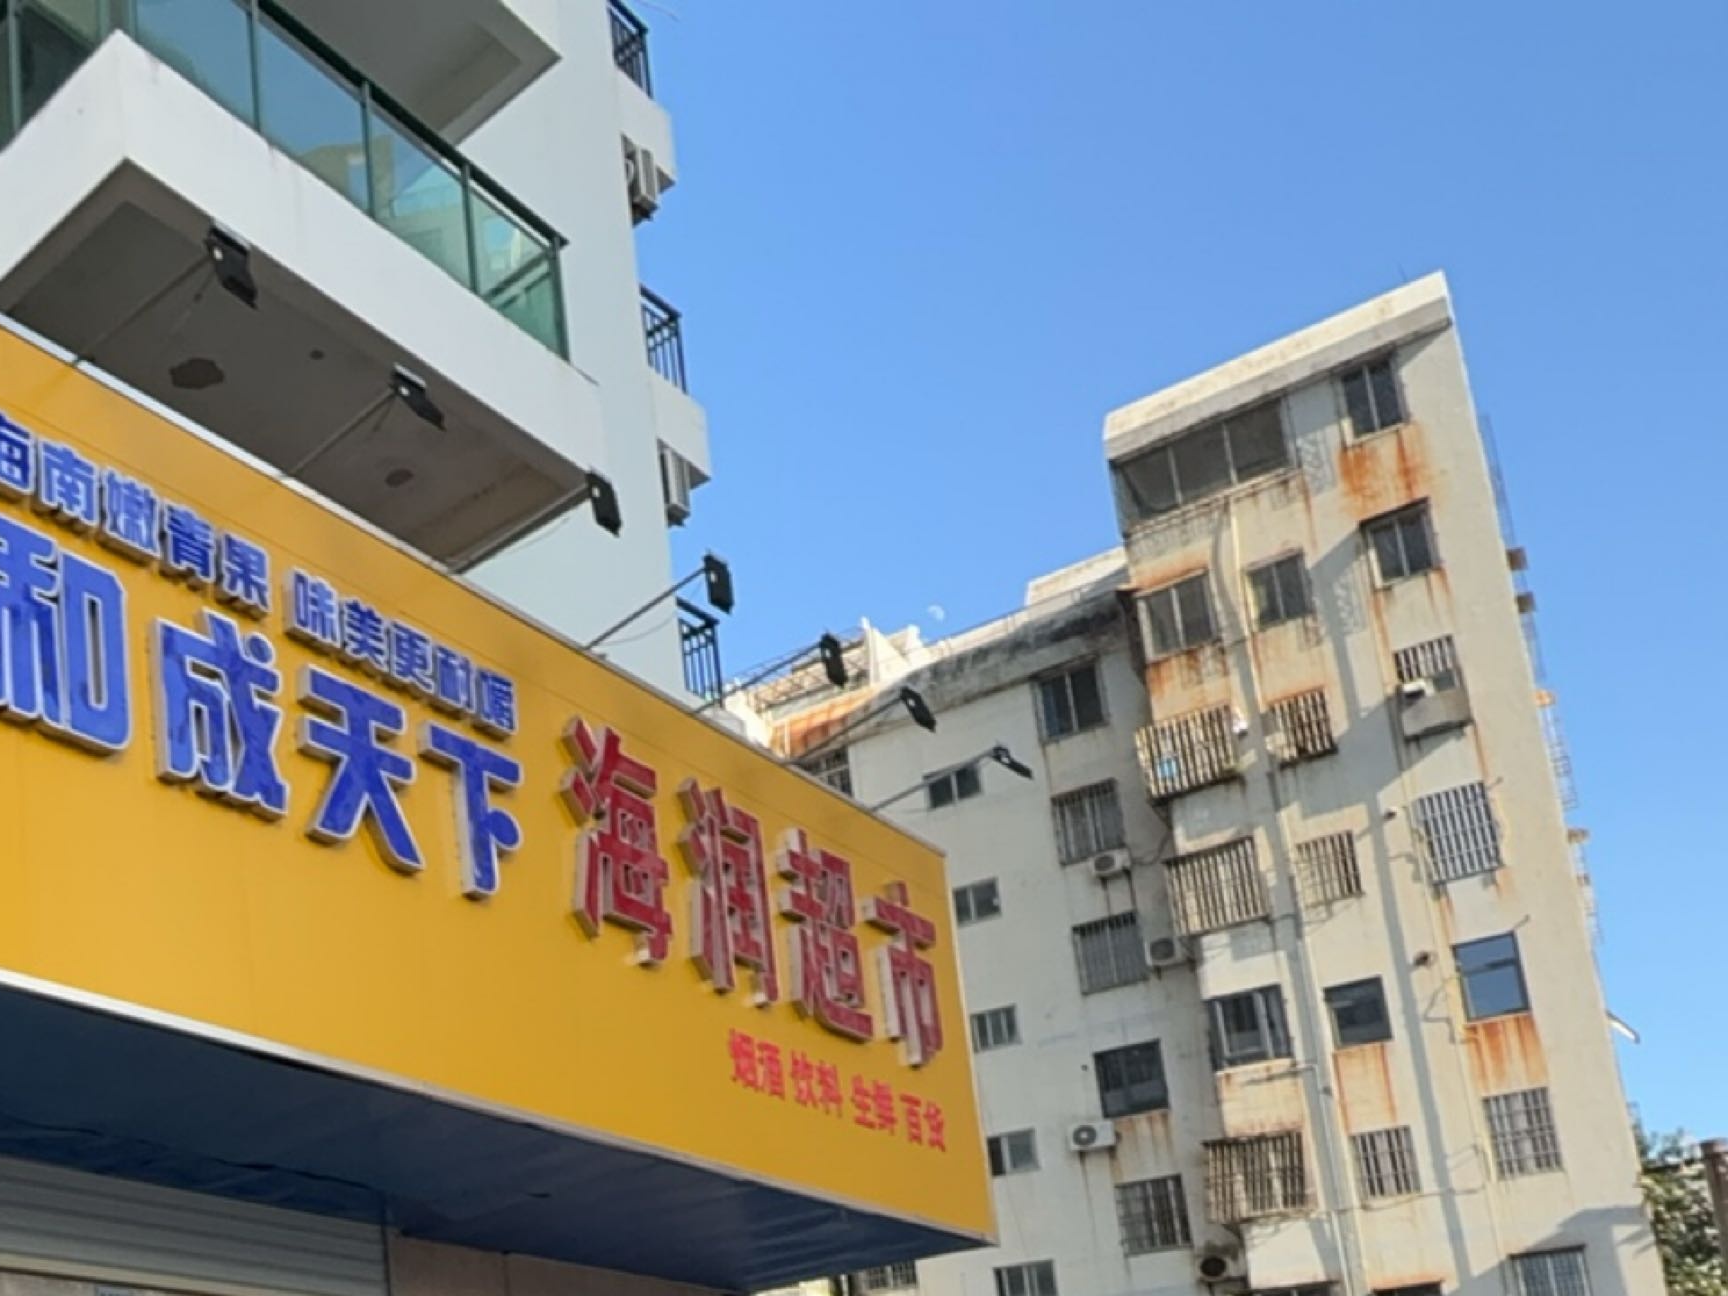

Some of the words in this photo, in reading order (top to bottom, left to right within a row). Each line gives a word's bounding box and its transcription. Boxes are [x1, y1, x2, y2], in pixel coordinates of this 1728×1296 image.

[562, 715, 945, 1068] 海润超市
[729, 1030, 786, 1100] 烟酒
[790, 1049, 844, 1118] 饮料
[851, 1074, 899, 1136] 生鲜
[900, 1093, 947, 1153] 百货
